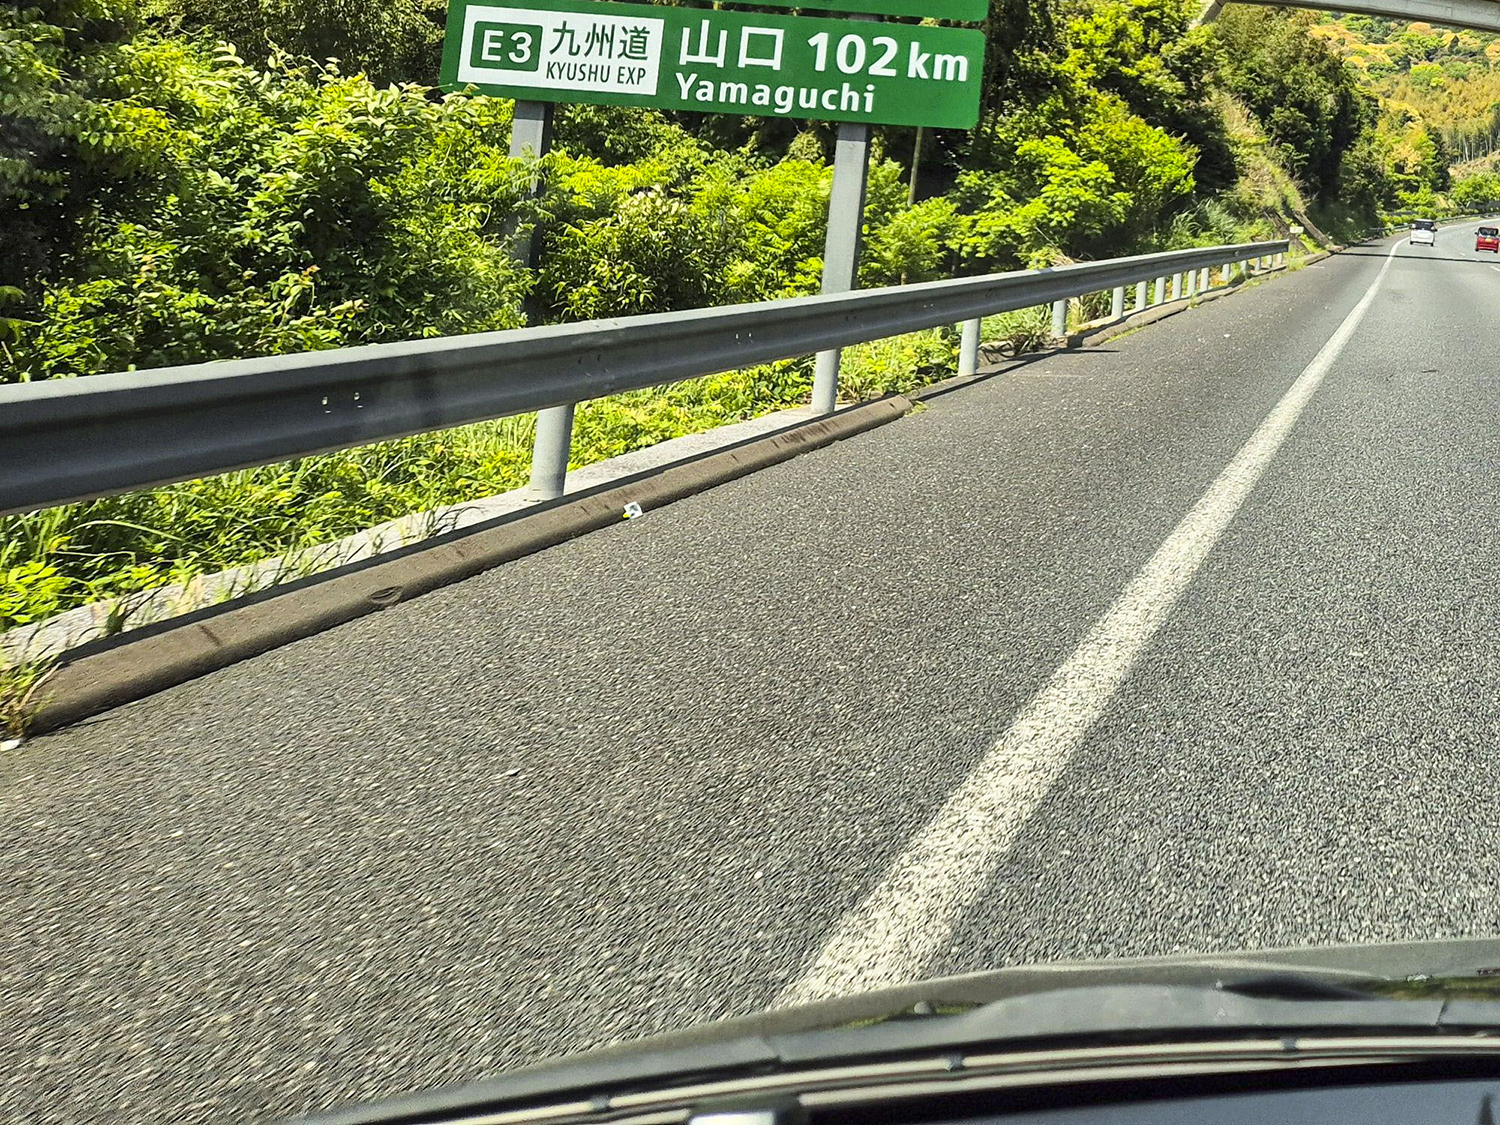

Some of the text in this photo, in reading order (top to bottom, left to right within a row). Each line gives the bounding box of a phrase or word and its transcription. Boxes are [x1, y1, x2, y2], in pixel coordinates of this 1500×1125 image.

[482, 30, 533, 64] E3
[550, 21, 651, 61] 九州道
[679, 20, 785, 71] 山口
[547, 62, 646, 85] KYUSHU EXP
[676, 73, 875, 114] Yamaguchi
